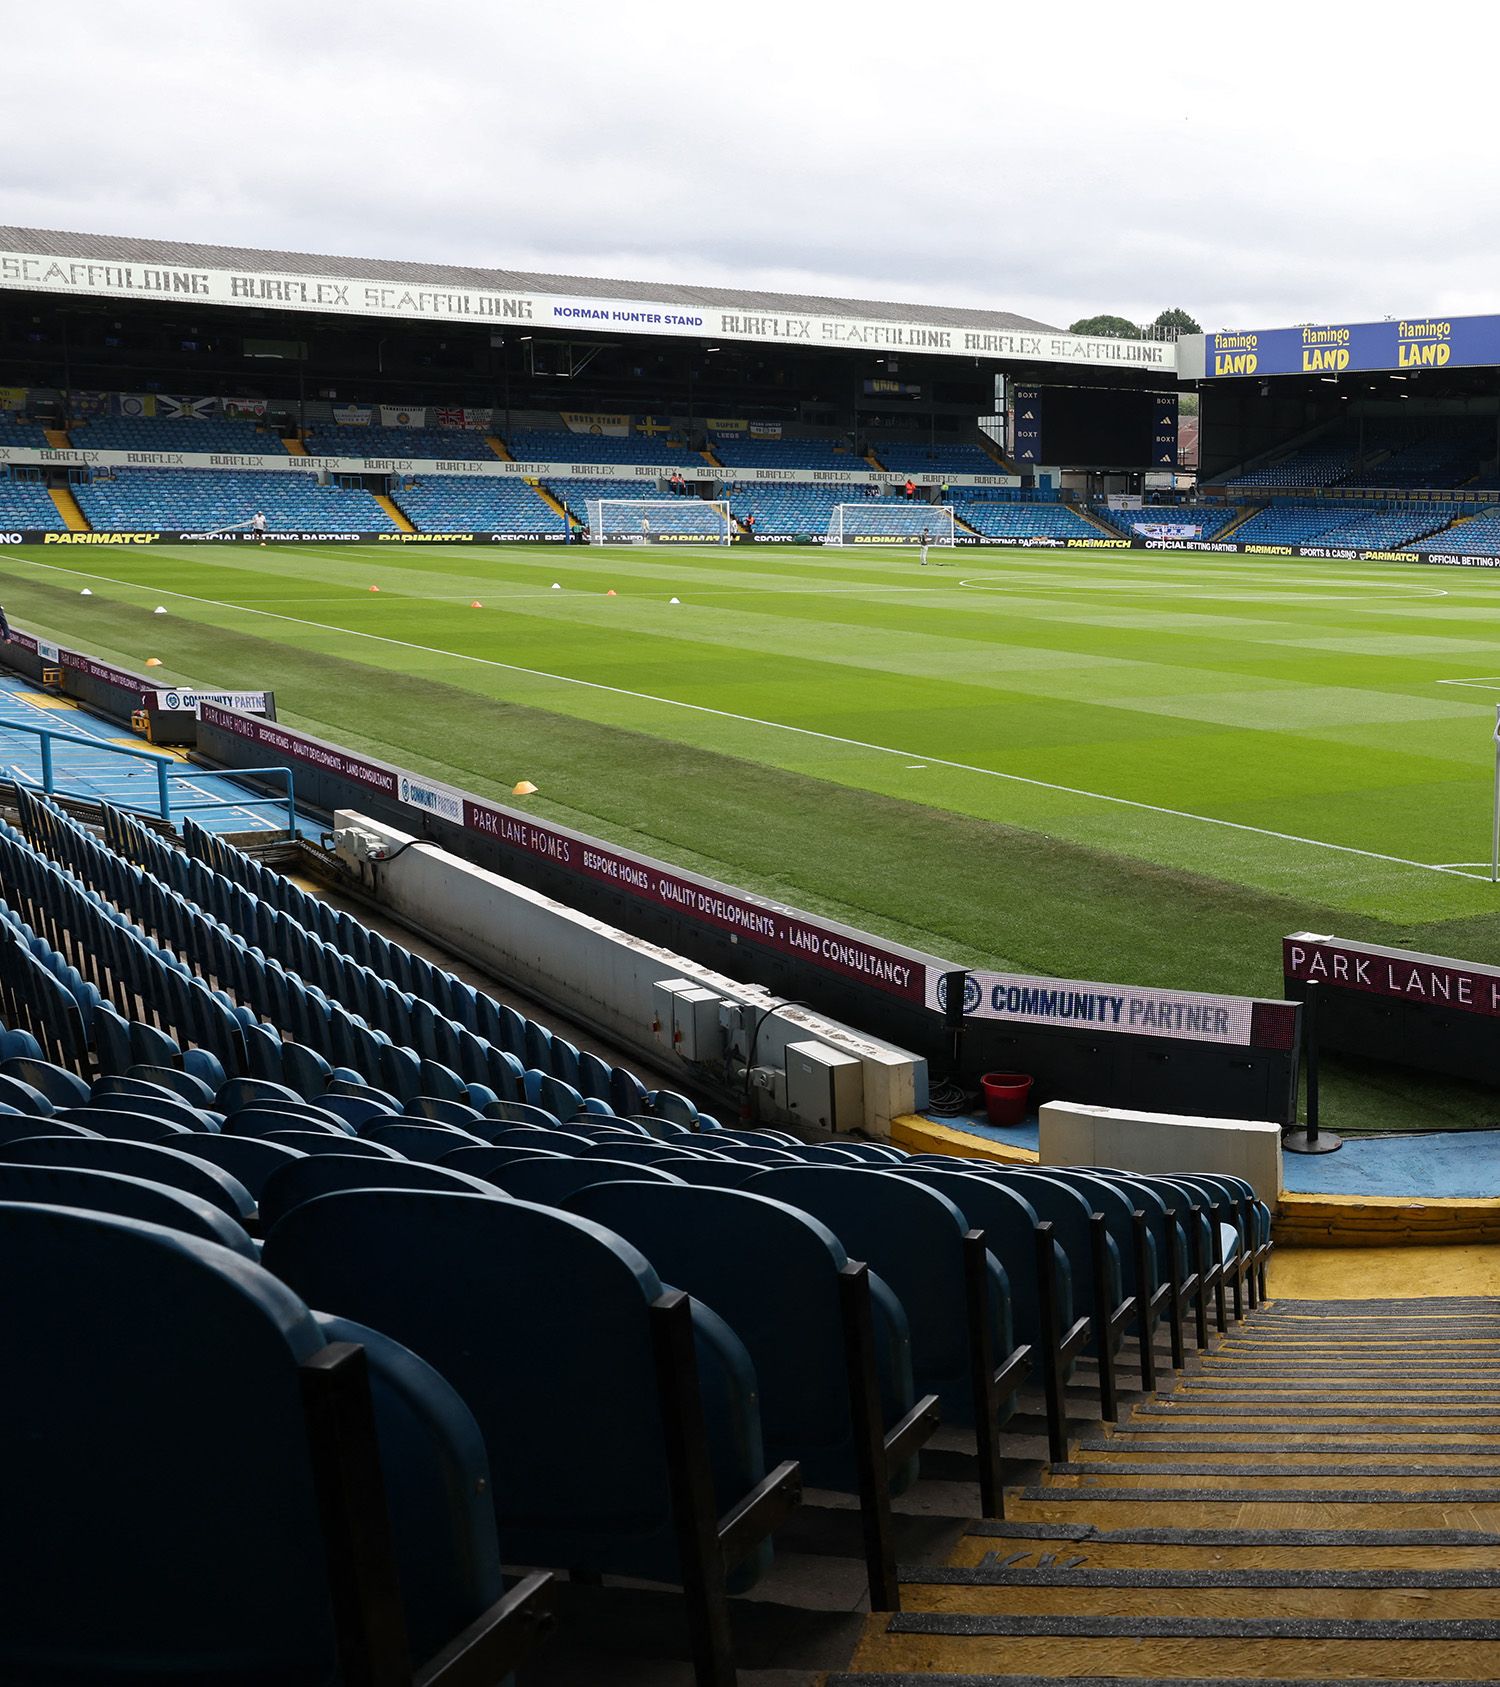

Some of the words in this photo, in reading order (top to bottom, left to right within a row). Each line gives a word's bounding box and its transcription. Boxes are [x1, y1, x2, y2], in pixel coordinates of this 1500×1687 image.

[2, 257, 209, 295] SCAFFOLDING
[231, 277, 349, 305] BURFLEX
[365, 288, 533, 319] SCAFFOLDING
[553, 306, 609, 320] NORMAN
[612, 310, 661, 324] HUNTER
[664, 314, 703, 326] STAND
[1303, 326, 1349, 345] flamingo
[1398, 320, 1450, 340] flamingo
[722, 315, 810, 338] BURFLEX
[822, 322, 951, 348] SCAFFOLDING
[964, 333, 1041, 355] BURFLEX
[1051, 340, 1163, 363] SCAFFOLDING
[1214, 333, 1257, 350] flamingo
[1303, 349, 1349, 371] LAND
[1398, 343, 1450, 367] LAND
[1215, 354, 1257, 375] LAND
[569, 415, 595, 424] SOUTH
[597, 417, 621, 425] STAND
[40, 450, 99, 462] BURFLEX
[127, 453, 183, 464] BURFLEX
[210, 456, 263, 466] BURFLEX
[289, 457, 339, 468] BURFLEX
[364, 460, 413, 470] BURFLEX
[436, 462, 483, 472] BURFLEX
[505, 464, 550, 474] BURFLEX
[571, 466, 615, 475] BURFLEX
[635, 467, 677, 477] BURFLEX
[697, 469, 737, 478] BURFLEX
[756, 470, 795, 480] BURFLEX
[814, 472, 851, 481] BURFLEX
[869, 473, 905, 482] BURFLEX
[922, 475, 958, 483] BURFLEX
[974, 476, 1008, 485] BURFLEX
[44, 533, 160, 544] PARIMATCH
[754, 535, 792, 543] SPORTS
[1067, 539, 1131, 548] PARIMATCH
[1145, 540, 1186, 550] OFFICIAL
[1187, 541, 1210, 551] BETTING
[1211, 542, 1237, 552] PARTNER
[1245, 545, 1292, 555] PARIMATCH
[1300, 548, 1324, 557] SPORTS
[1331, 550, 1356, 560] CASINO
[1365, 552, 1419, 562] PARIMATCH
[1429, 554, 1461, 564] OFFICIAL
[1462, 556, 1493, 566] BETTING
[205, 707, 219, 722] PARK
[219, 713, 234, 731] LANE
[234, 718, 254, 738] HOMES
[259, 728, 275, 746] BESPOKE
[346, 761, 359, 778] LAND
[473, 808, 498, 835] PARK
[501, 821, 527, 846] LANE
[531, 831, 570, 862] HOMES
[583, 850, 617, 878] BESPOKE
[619, 864, 648, 890] HOMES
[659, 879, 697, 910] QUALITY
[698, 893, 774, 938] DEVELOPMENTS
[789, 926, 819, 954] LAND
[821, 939, 911, 988] CONSULTANCY
[1291, 946, 1371, 985] PARK
[1388, 963, 1473, 1005] LANE
[991, 984, 1124, 1024] COMMUNITY
[1129, 999, 1229, 1035] PARTNER
